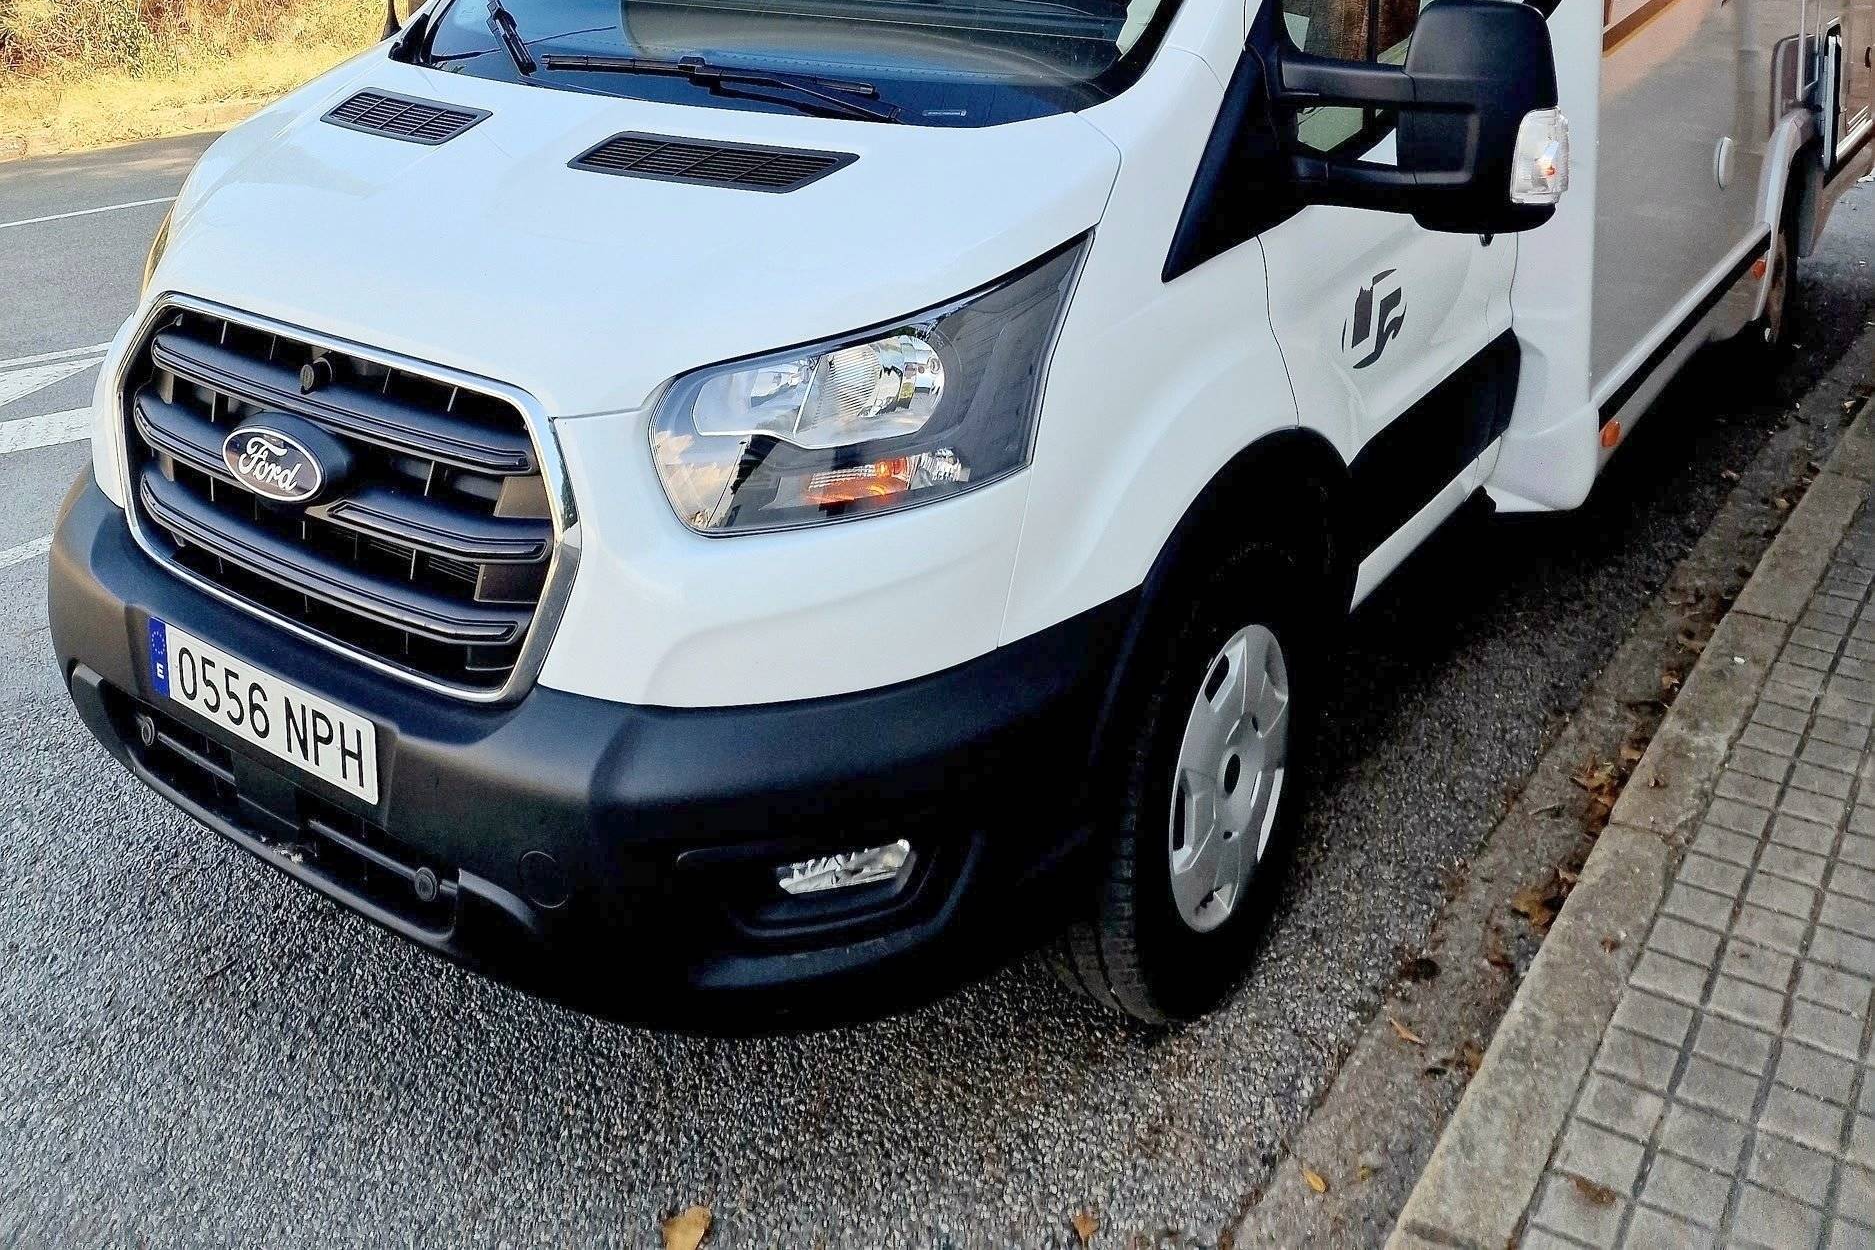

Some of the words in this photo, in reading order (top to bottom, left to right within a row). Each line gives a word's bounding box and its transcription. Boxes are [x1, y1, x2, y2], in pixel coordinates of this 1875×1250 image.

[239, 436, 302, 491] Ford
[156, 662, 165, 679] E
[178, 647, 270, 739] 0556
[284, 696, 364, 788] NPH
